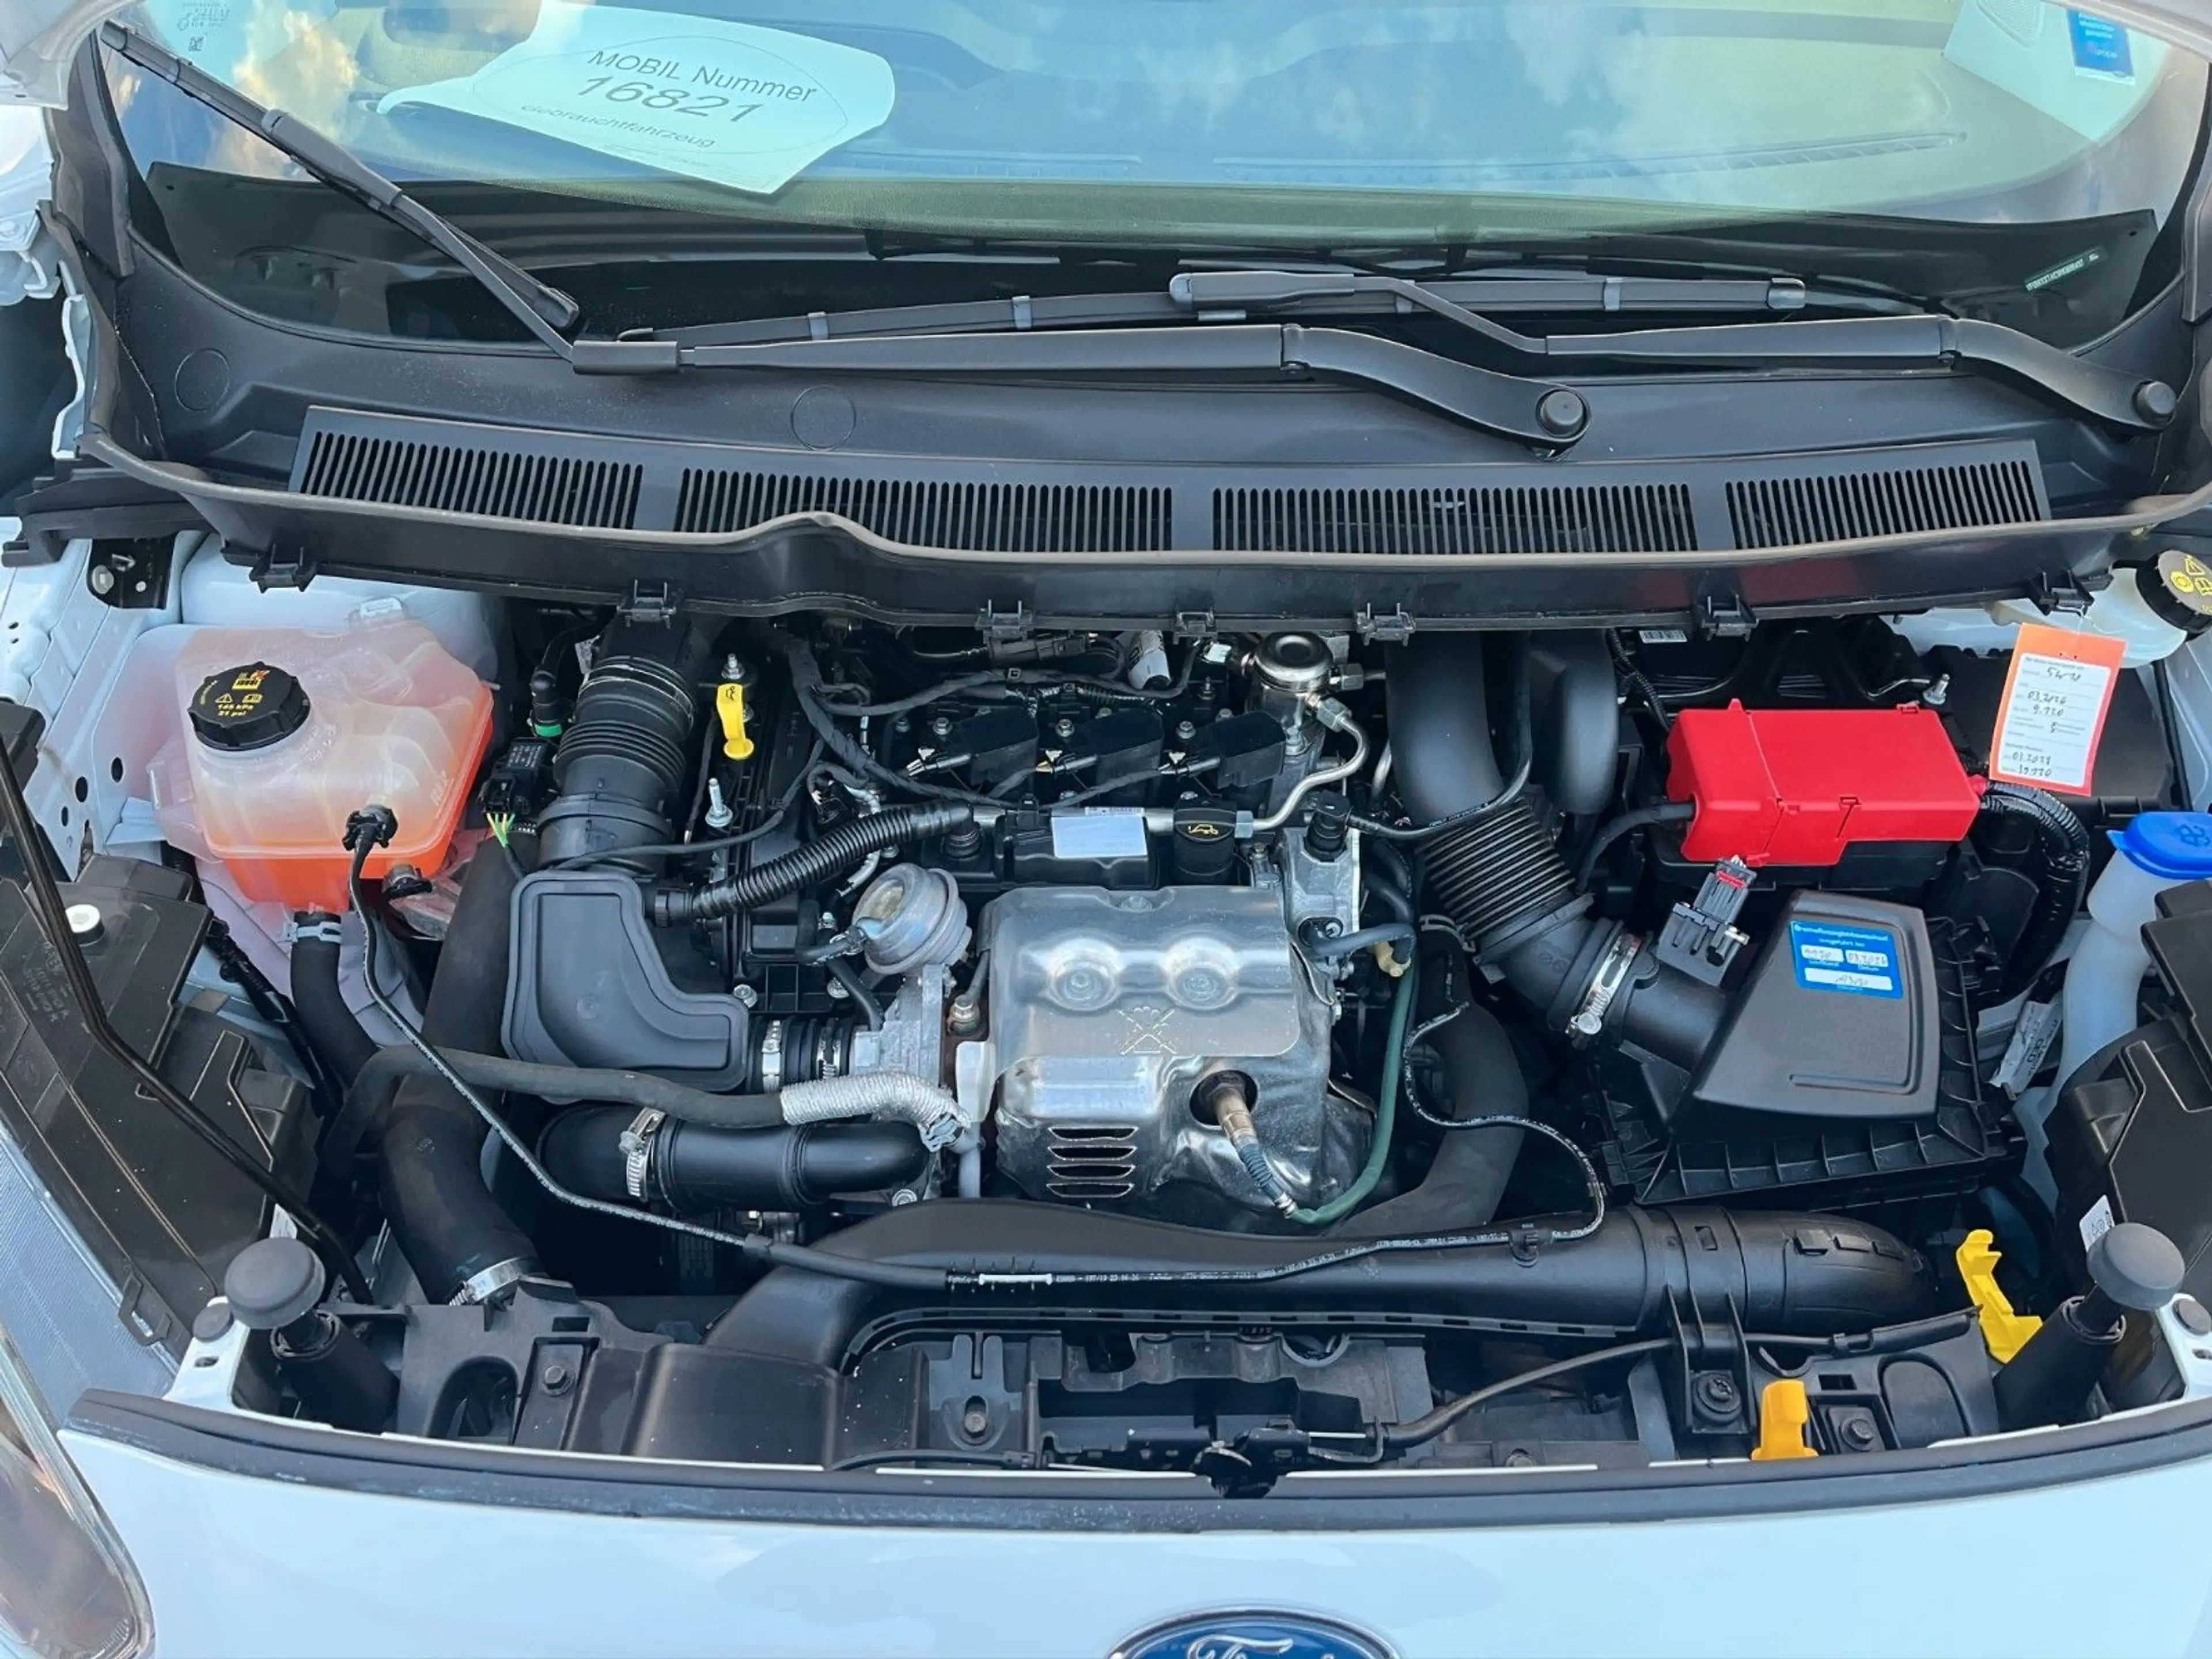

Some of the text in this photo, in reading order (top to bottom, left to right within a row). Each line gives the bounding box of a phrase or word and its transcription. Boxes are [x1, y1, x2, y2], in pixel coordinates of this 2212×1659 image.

[578, 75, 764, 123] 16821
[588, 50, 817, 103] MOBIL Nummer
